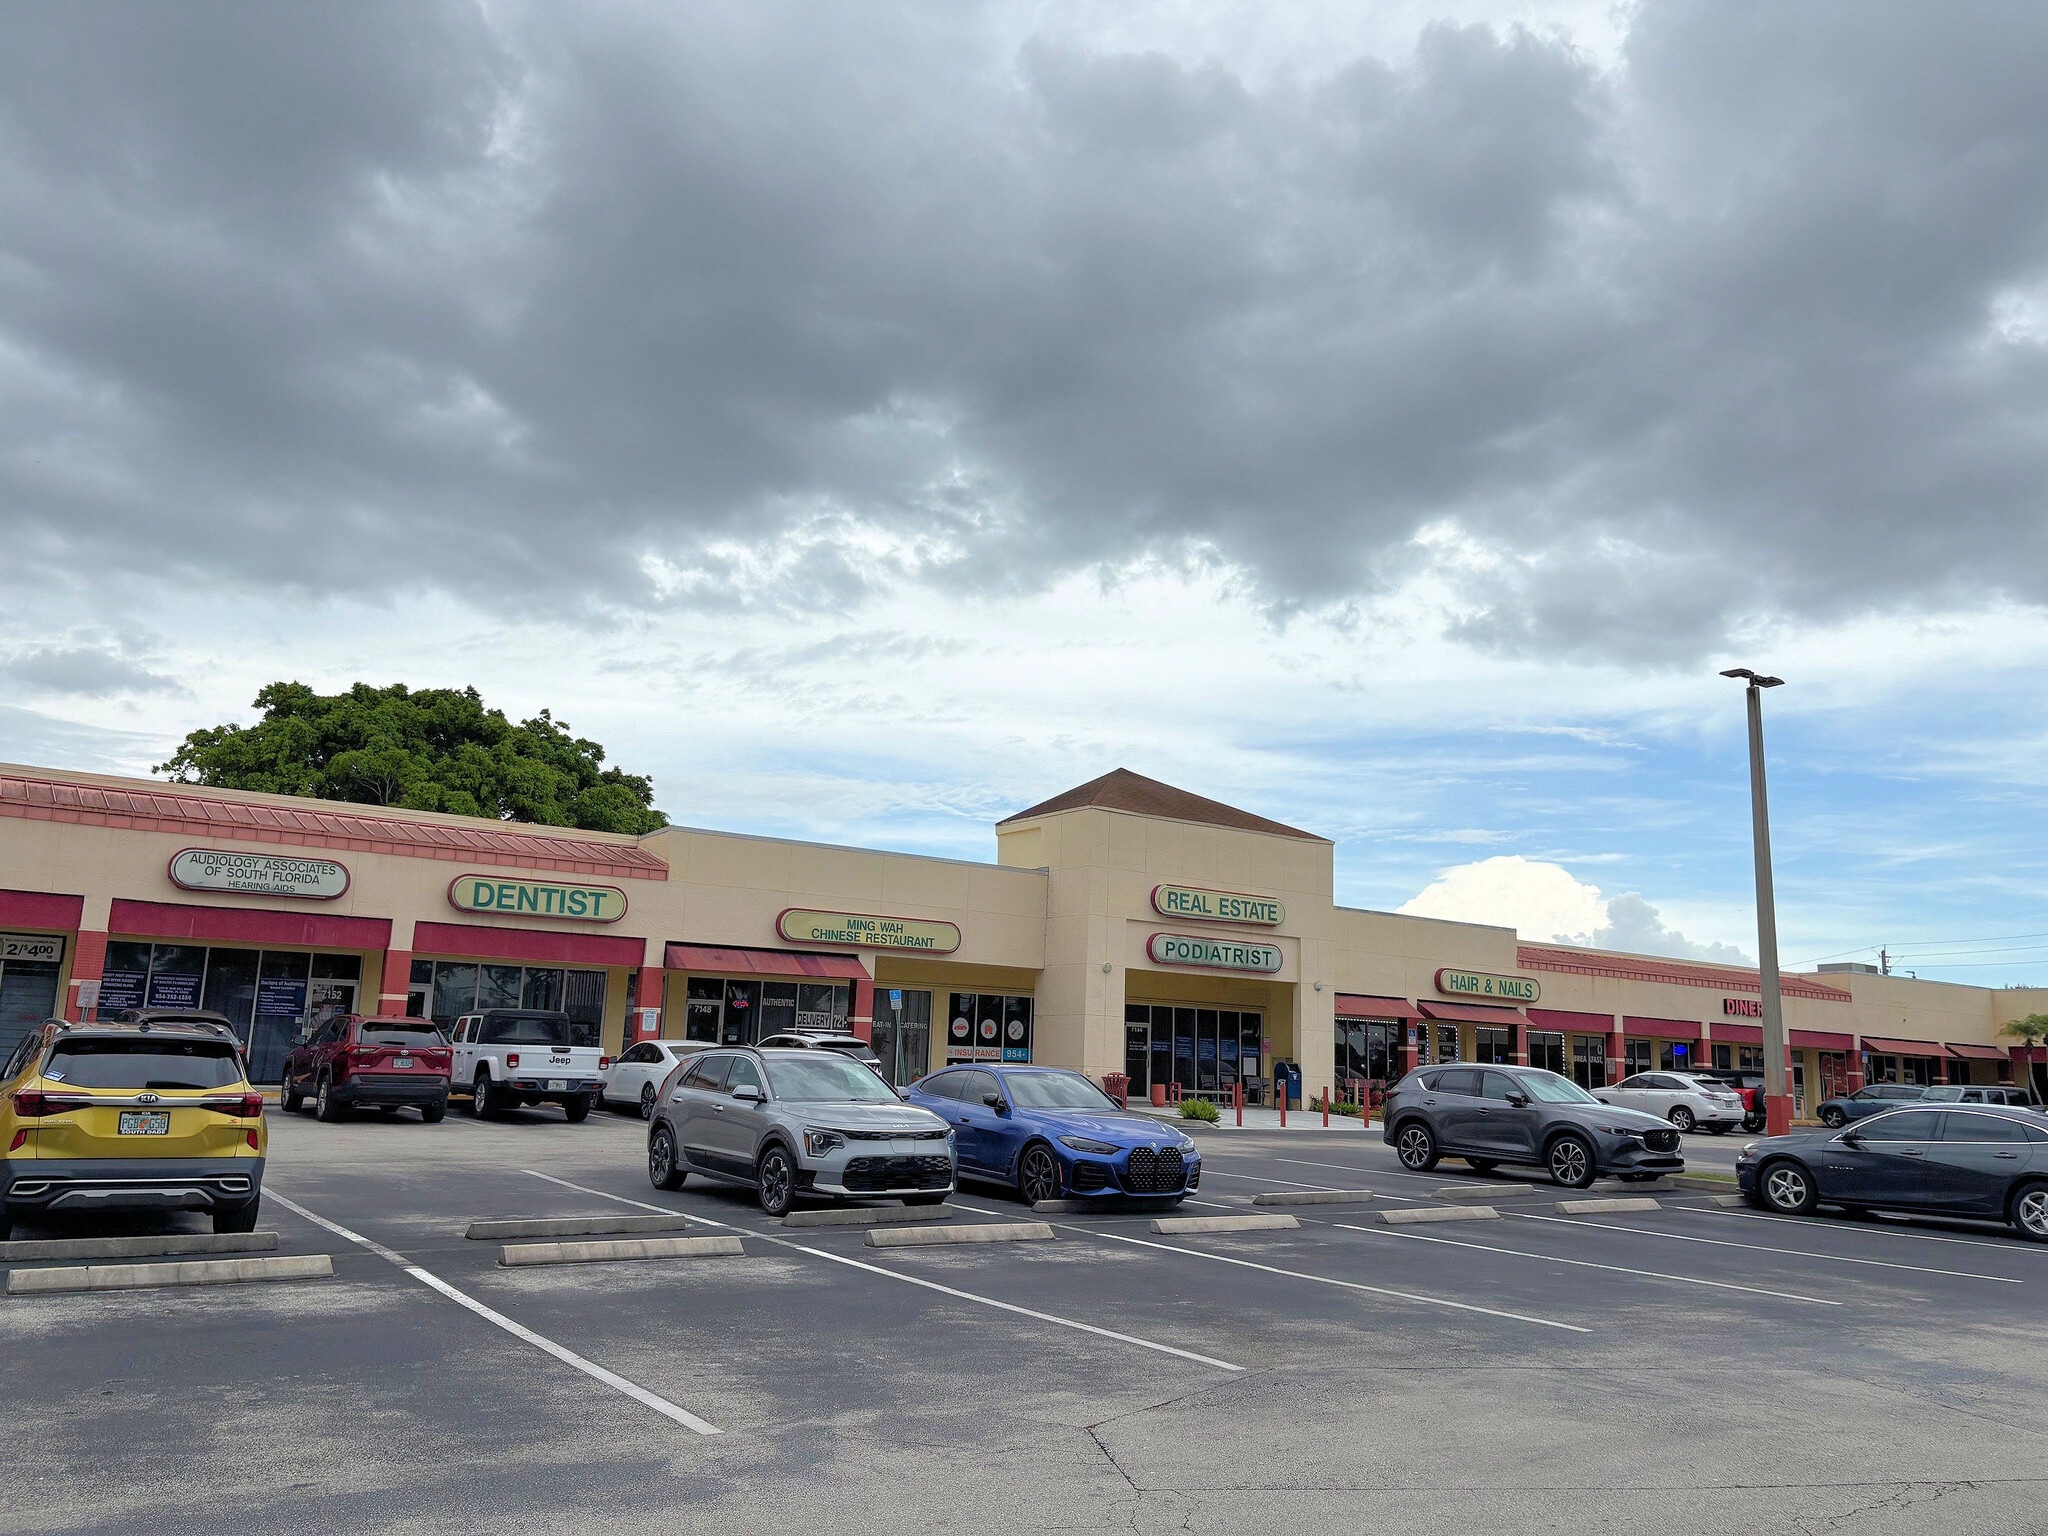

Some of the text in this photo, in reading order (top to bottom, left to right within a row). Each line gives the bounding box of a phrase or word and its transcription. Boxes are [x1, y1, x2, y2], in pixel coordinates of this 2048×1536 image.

[189, 853, 336, 875] AUDIOLOGY ASSOCIATES
[204, 865, 321, 885] OF SOUTH FLORIDA
[228, 880, 296, 893] HEARING AIDS
[473, 882, 607, 916] DENTIST
[1167, 891, 1278, 922] REAL ESTATE
[846, 918, 904, 935] MING WAH
[811, 928, 935, 949] CHINESE RESTAURANT
[1165, 941, 1272, 966] PODIATRIST
[321, 990, 342, 1000] 7152
[1450, 974, 1533, 999] HAIR & NAILS
[694, 1005, 712, 1014] 7148
[762, 997, 795, 1007] AUTHENTIC
[1727, 998, 1763, 1017] DINER
[798, 1013, 831, 1026] DELIVERY
[548, 1055, 571, 1066] Jeep
[954, 1048, 1001, 1058] INSURANCE
[1006, 1049, 1025, 1058] 954-
